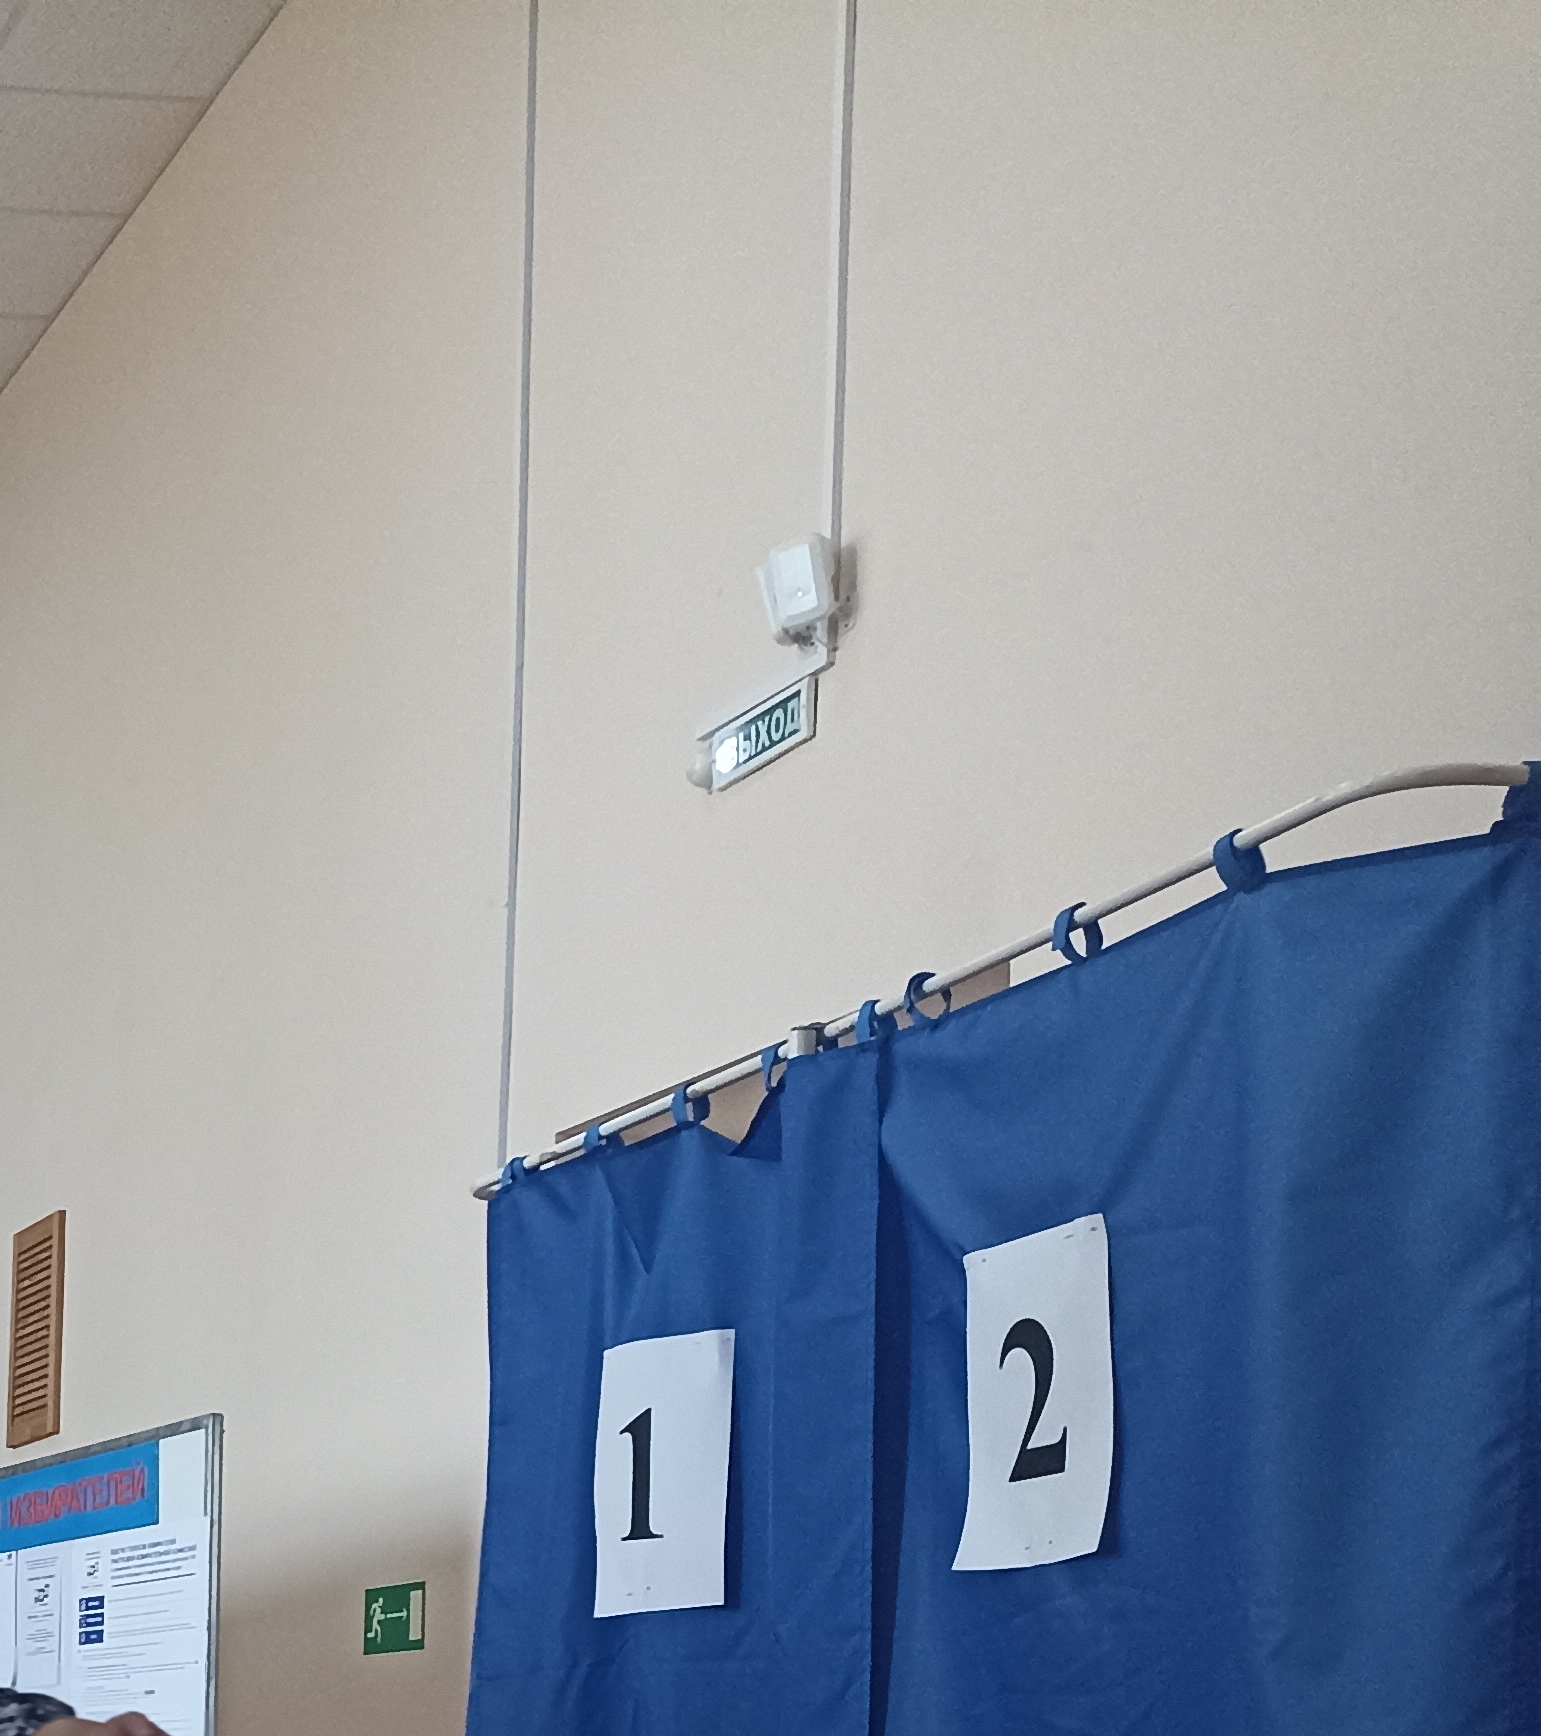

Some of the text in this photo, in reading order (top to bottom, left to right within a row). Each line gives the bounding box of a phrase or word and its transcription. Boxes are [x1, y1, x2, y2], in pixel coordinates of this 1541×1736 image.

[716, 697, 801, 773] ВЫХОД
[999, 1318, 1068, 1482] 2
[10, 1460, 147, 1528] ИЗБИРАТЕЛЕЙ
[619, 1407, 664, 1541] 1
